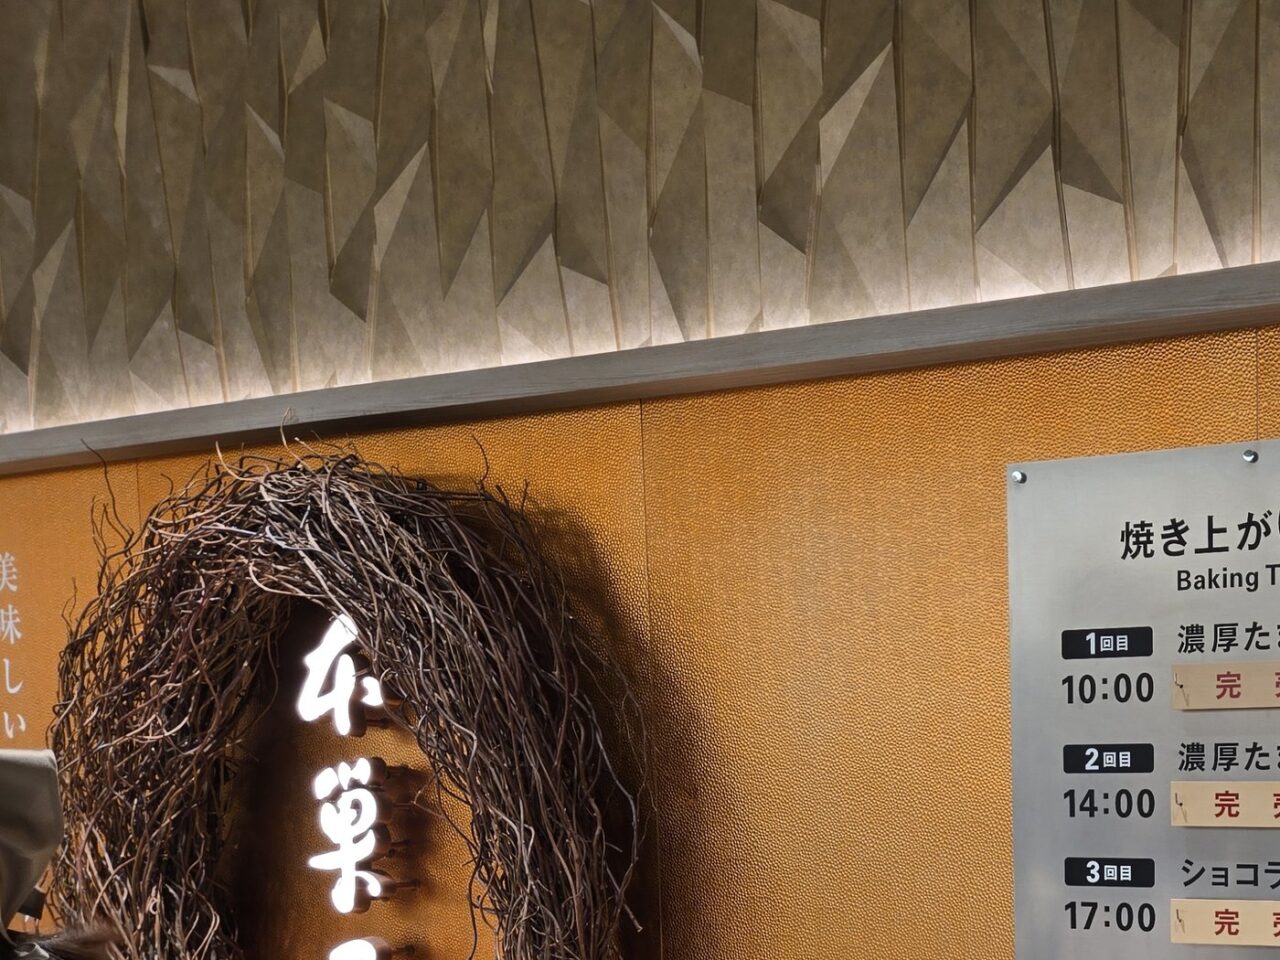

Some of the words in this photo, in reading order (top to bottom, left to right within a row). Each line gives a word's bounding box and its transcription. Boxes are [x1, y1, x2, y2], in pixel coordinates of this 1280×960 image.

[1177, 567, 1259, 592] Baking
[1085, 632, 1130, 656] 1回目
[1061, 672, 1154, 704] 10:00
[1085, 747, 1131, 770] 2回目
[1063, 788, 1156, 819] 14:00
[1086, 861, 1132, 883] 3回目
[1064, 901, 1156, 933] 17:00
